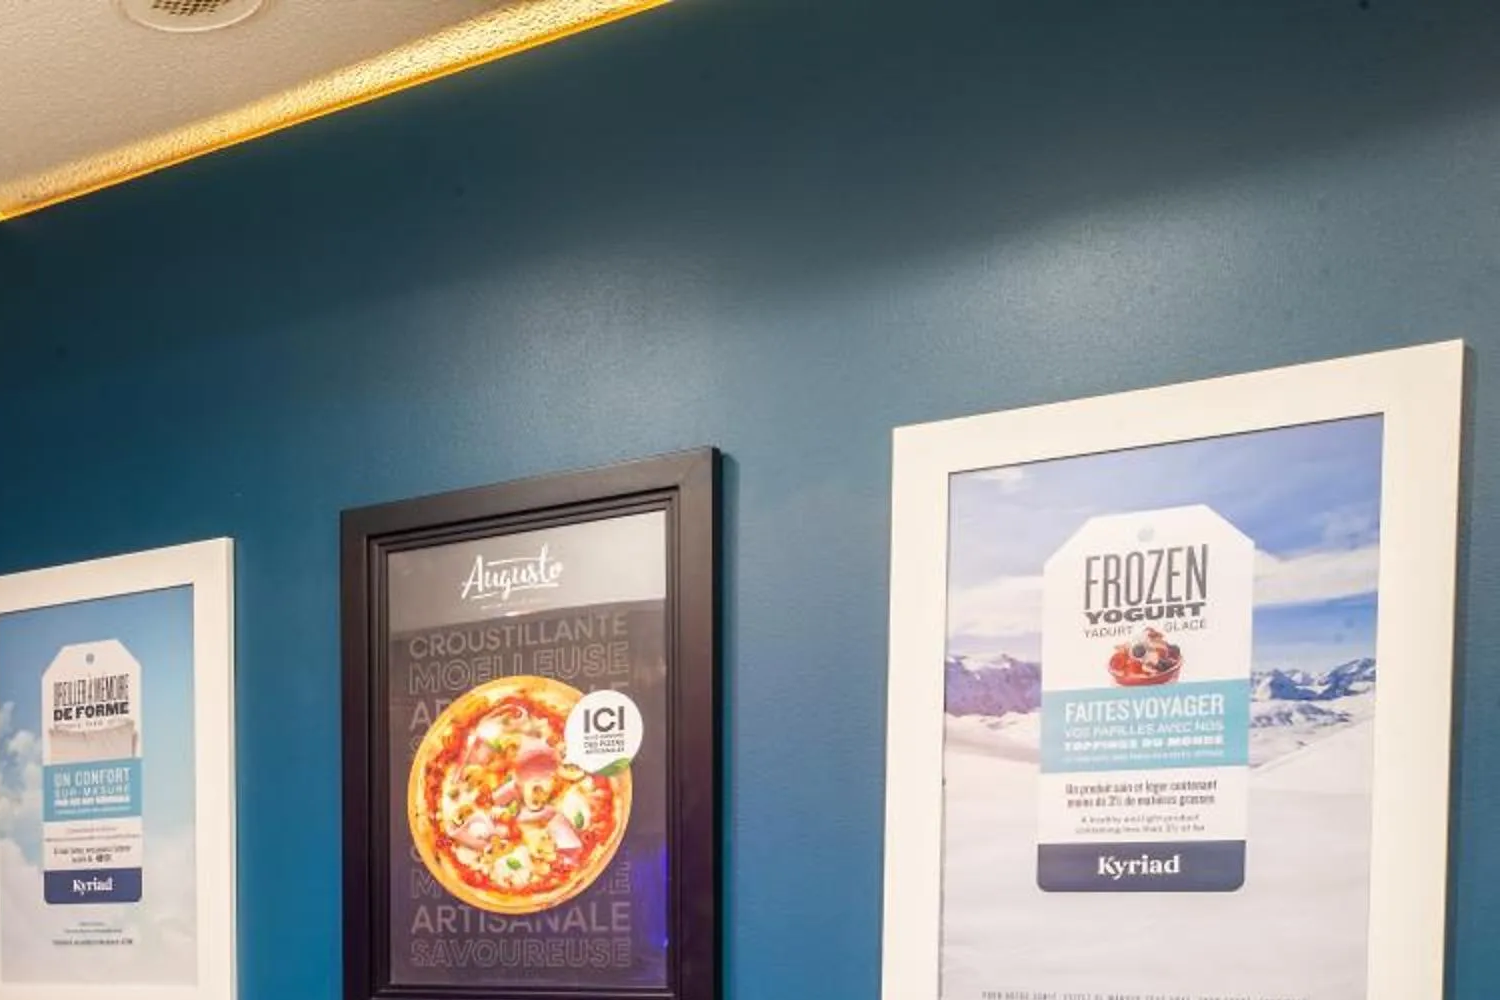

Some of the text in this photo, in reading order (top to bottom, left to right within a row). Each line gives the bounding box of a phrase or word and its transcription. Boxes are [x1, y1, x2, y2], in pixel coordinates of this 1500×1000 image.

[461, 543, 563, 600] Augusto
[1084, 543, 1208, 610] FROZEN
[1084, 601, 1206, 625] YOGURT
[409, 611, 629, 659] CROUSTILLANTE
[1084, 625, 1133, 638] YAOURT
[53, 701, 129, 721] DE FORME
[584, 706, 625, 733] ICI
[1065, 693, 1225, 723] FAITES VOYAGER
[1093, 723, 1156, 738] PAPILLES
[1157, 722, 1192, 735] AVEC
[1141, 736, 1164, 749] DU
[1166, 735, 1225, 747] MONDE
[75, 766, 131, 787] CONFORT
[1097, 854, 1181, 880] Kyriad
[73, 877, 113, 896] Kyriad
[411, 901, 631, 933] ARTISANALE
[411, 937, 631, 967] SAVOUREUSE
